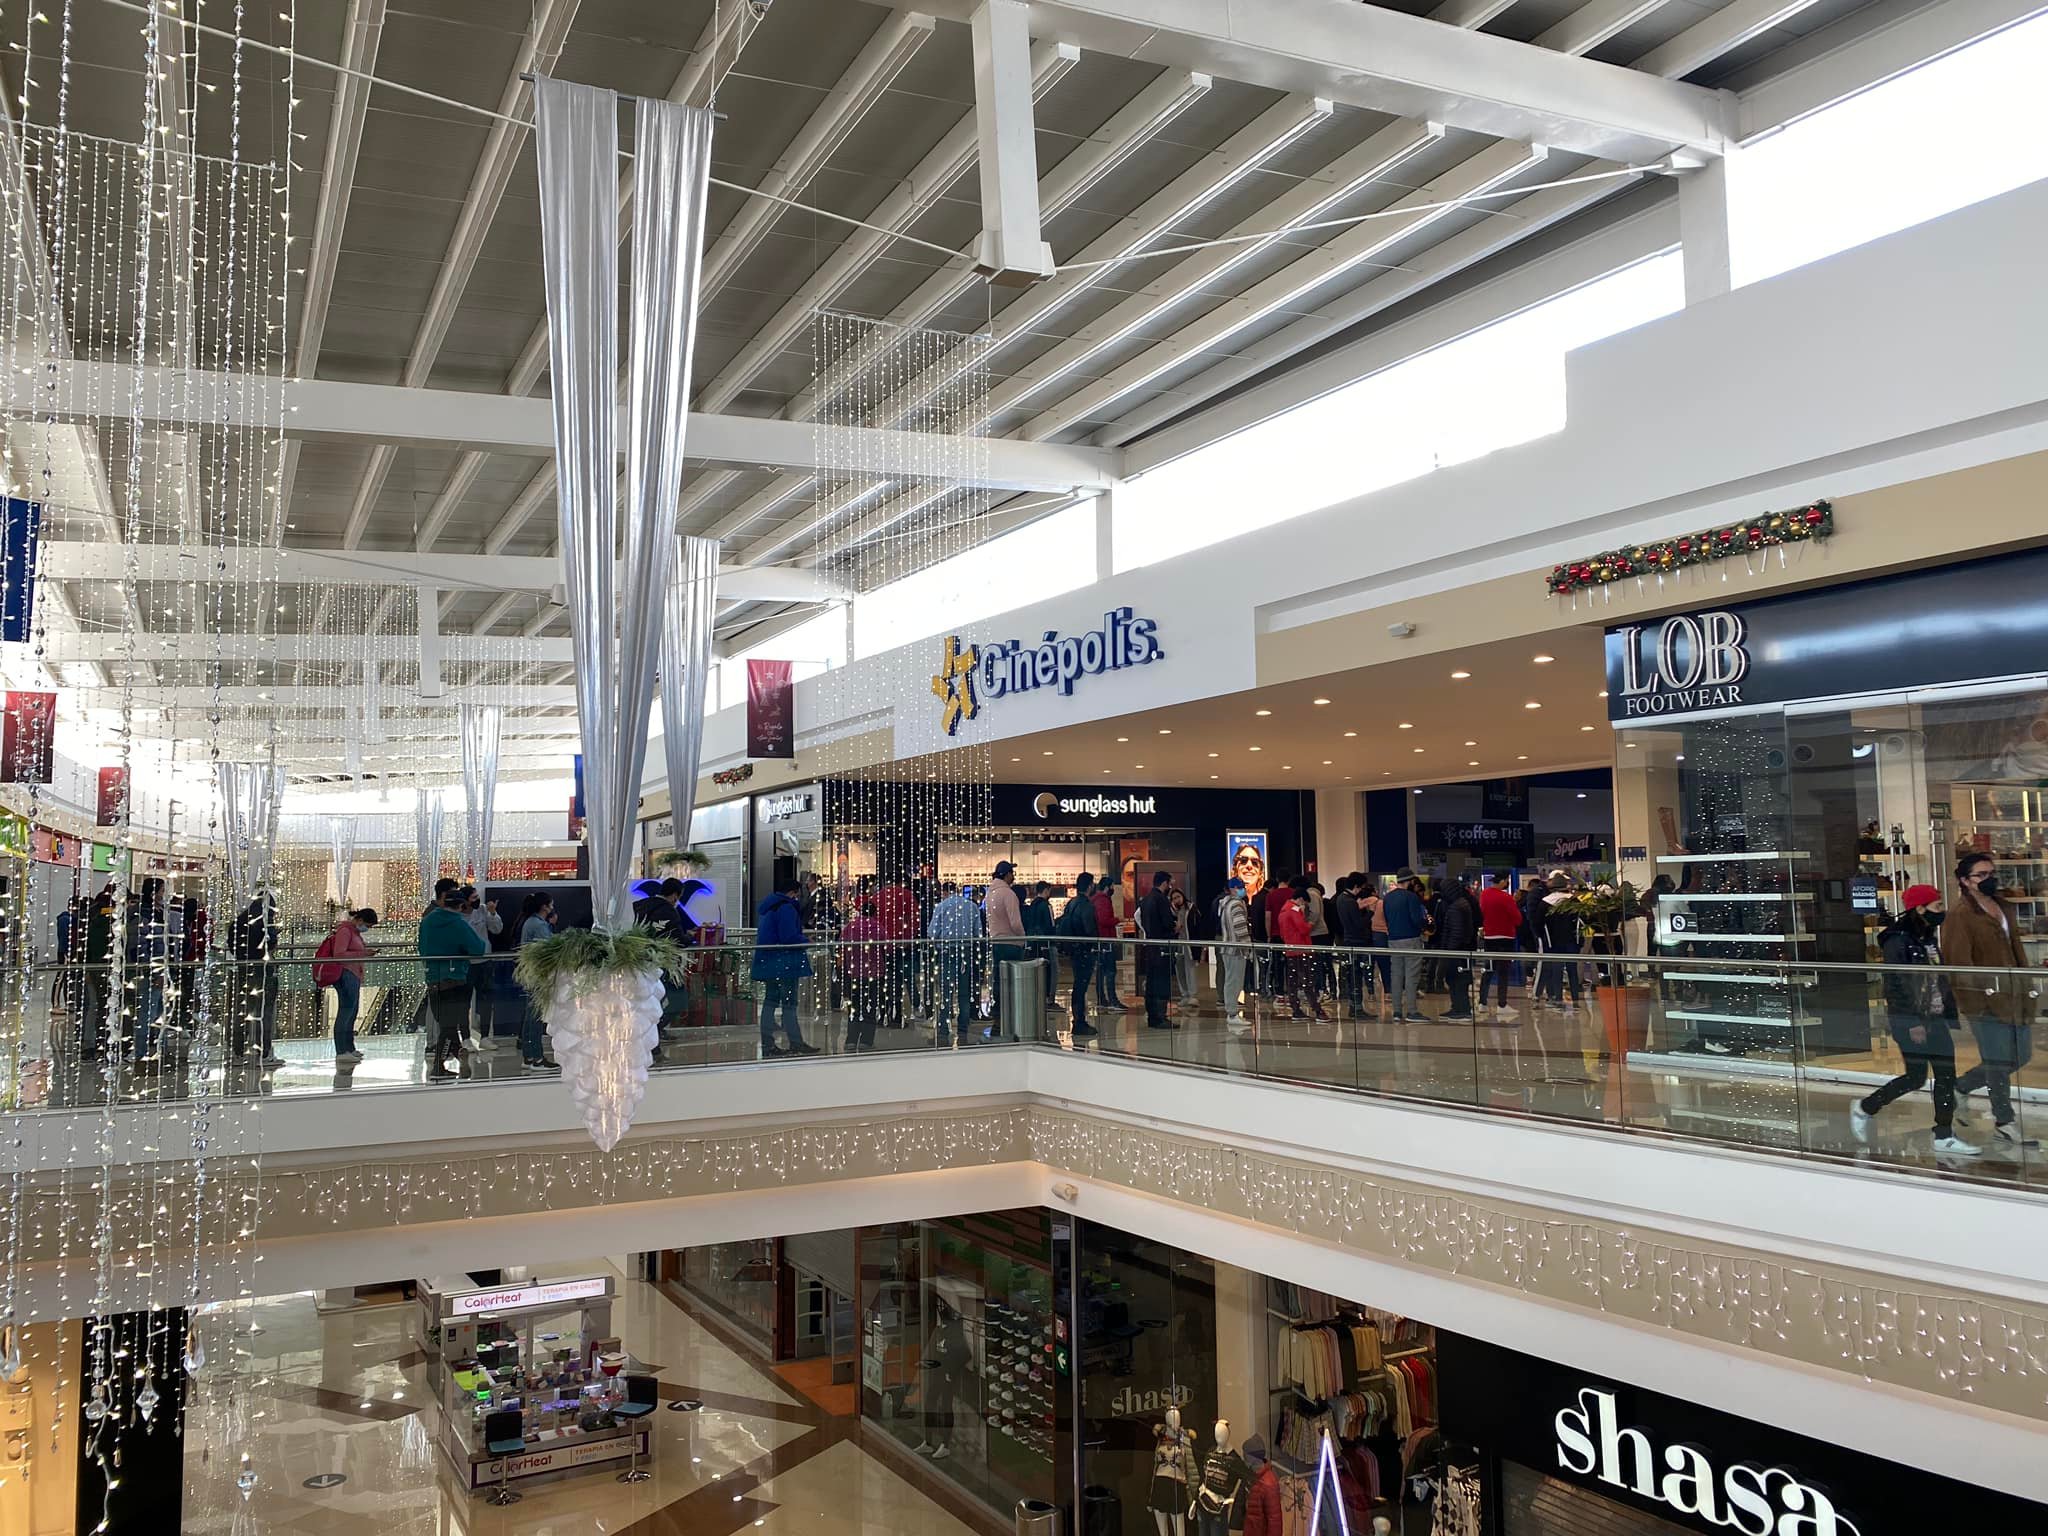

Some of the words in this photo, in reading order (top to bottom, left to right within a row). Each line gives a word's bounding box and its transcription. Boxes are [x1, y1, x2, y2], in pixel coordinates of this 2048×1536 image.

[1616, 611, 1746, 696] LOB
[1626, 685, 1743, 715] FOOTWEAR
[1060, 793, 1128, 817] sunglass
[1130, 794, 1156, 814] hut
[1459, 824, 1498, 839] coffee
[1553, 835, 1590, 857] Spyral
[1111, 1385, 1194, 1418] shasa
[1554, 1388, 1861, 1536] shasa
